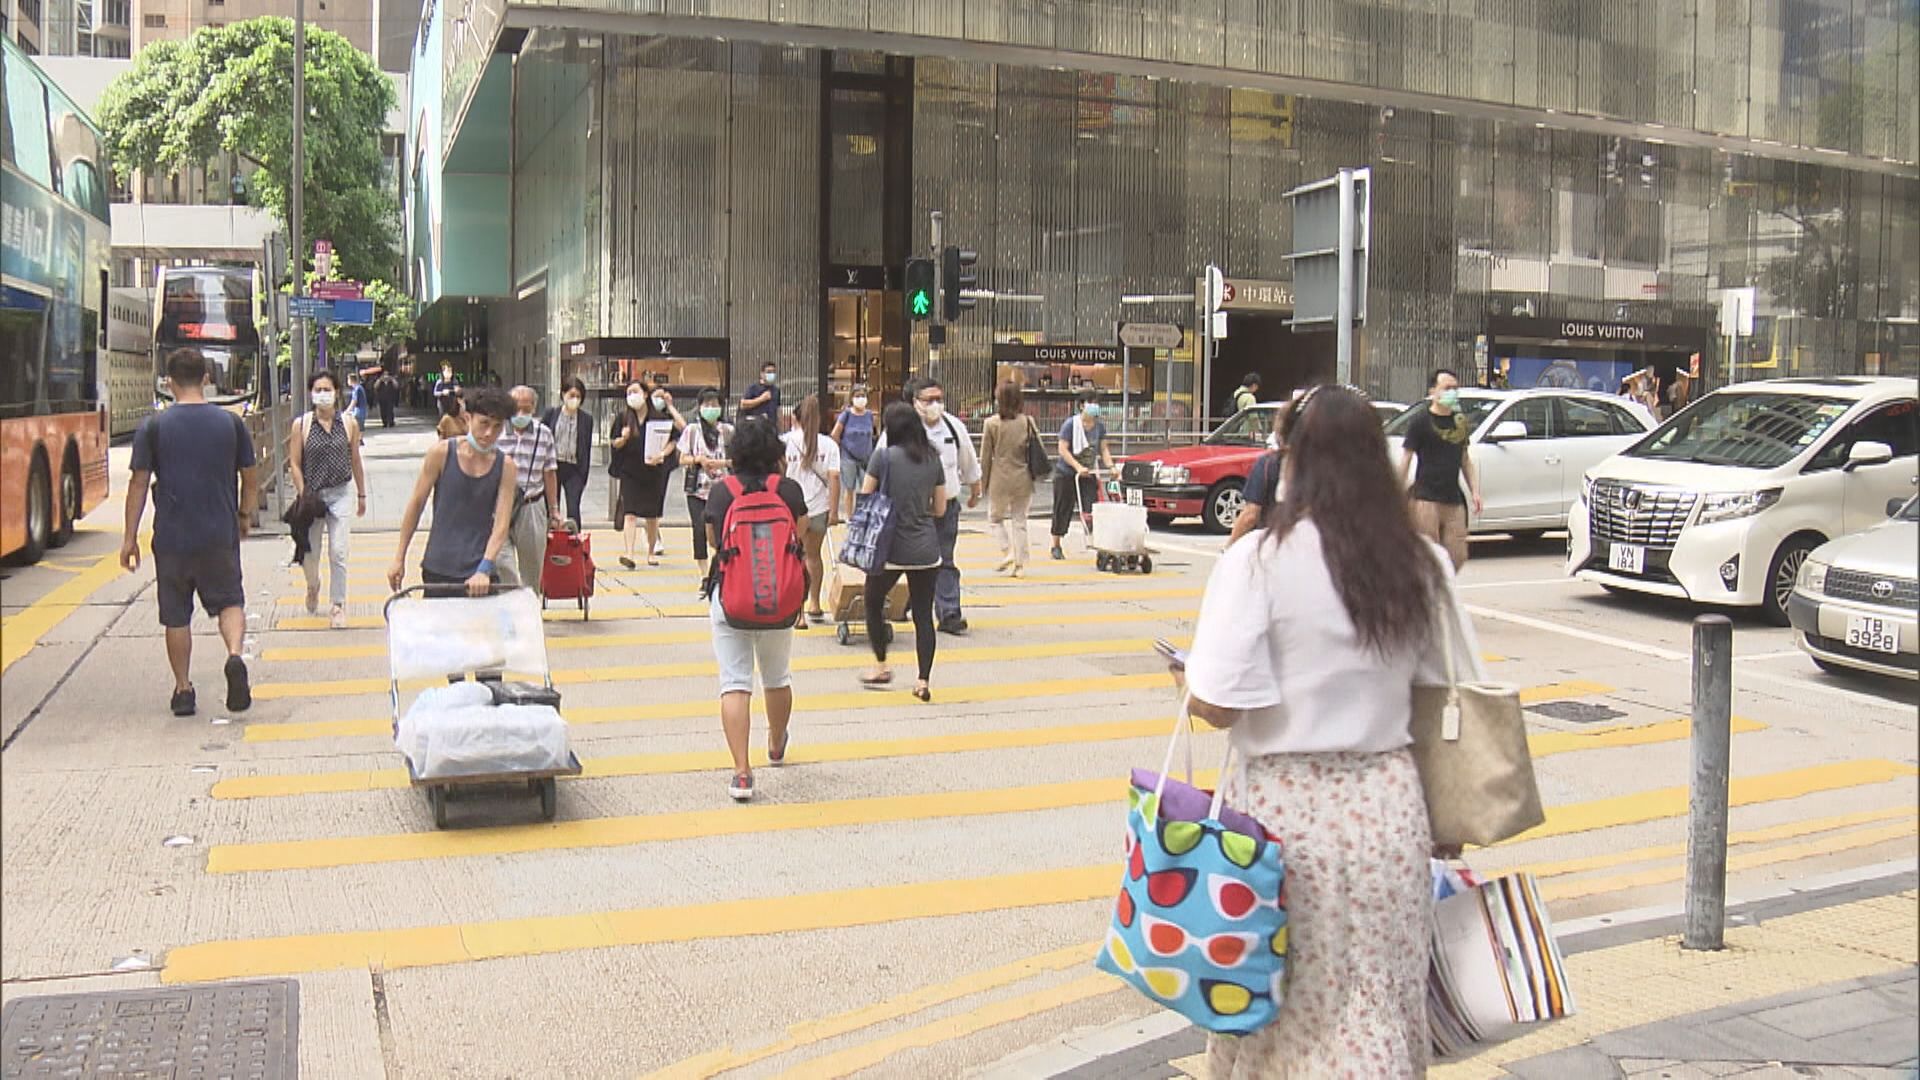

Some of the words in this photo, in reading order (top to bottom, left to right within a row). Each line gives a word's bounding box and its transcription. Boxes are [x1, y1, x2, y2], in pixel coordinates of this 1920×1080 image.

[1243, 285, 1286, 304] 中環站
[1561, 322, 1594, 337] LOUIS
[1597, 324, 1644, 340] VUITTON
[1035, 348, 1066, 360] LOUIS
[1070, 349, 1116, 361] VUITTON
[1620, 544, 1634, 558] VN
[1616, 556, 1634, 570] 184
[1862, 616, 1883, 633] TB
[1850, 629, 1894, 650] 3928
